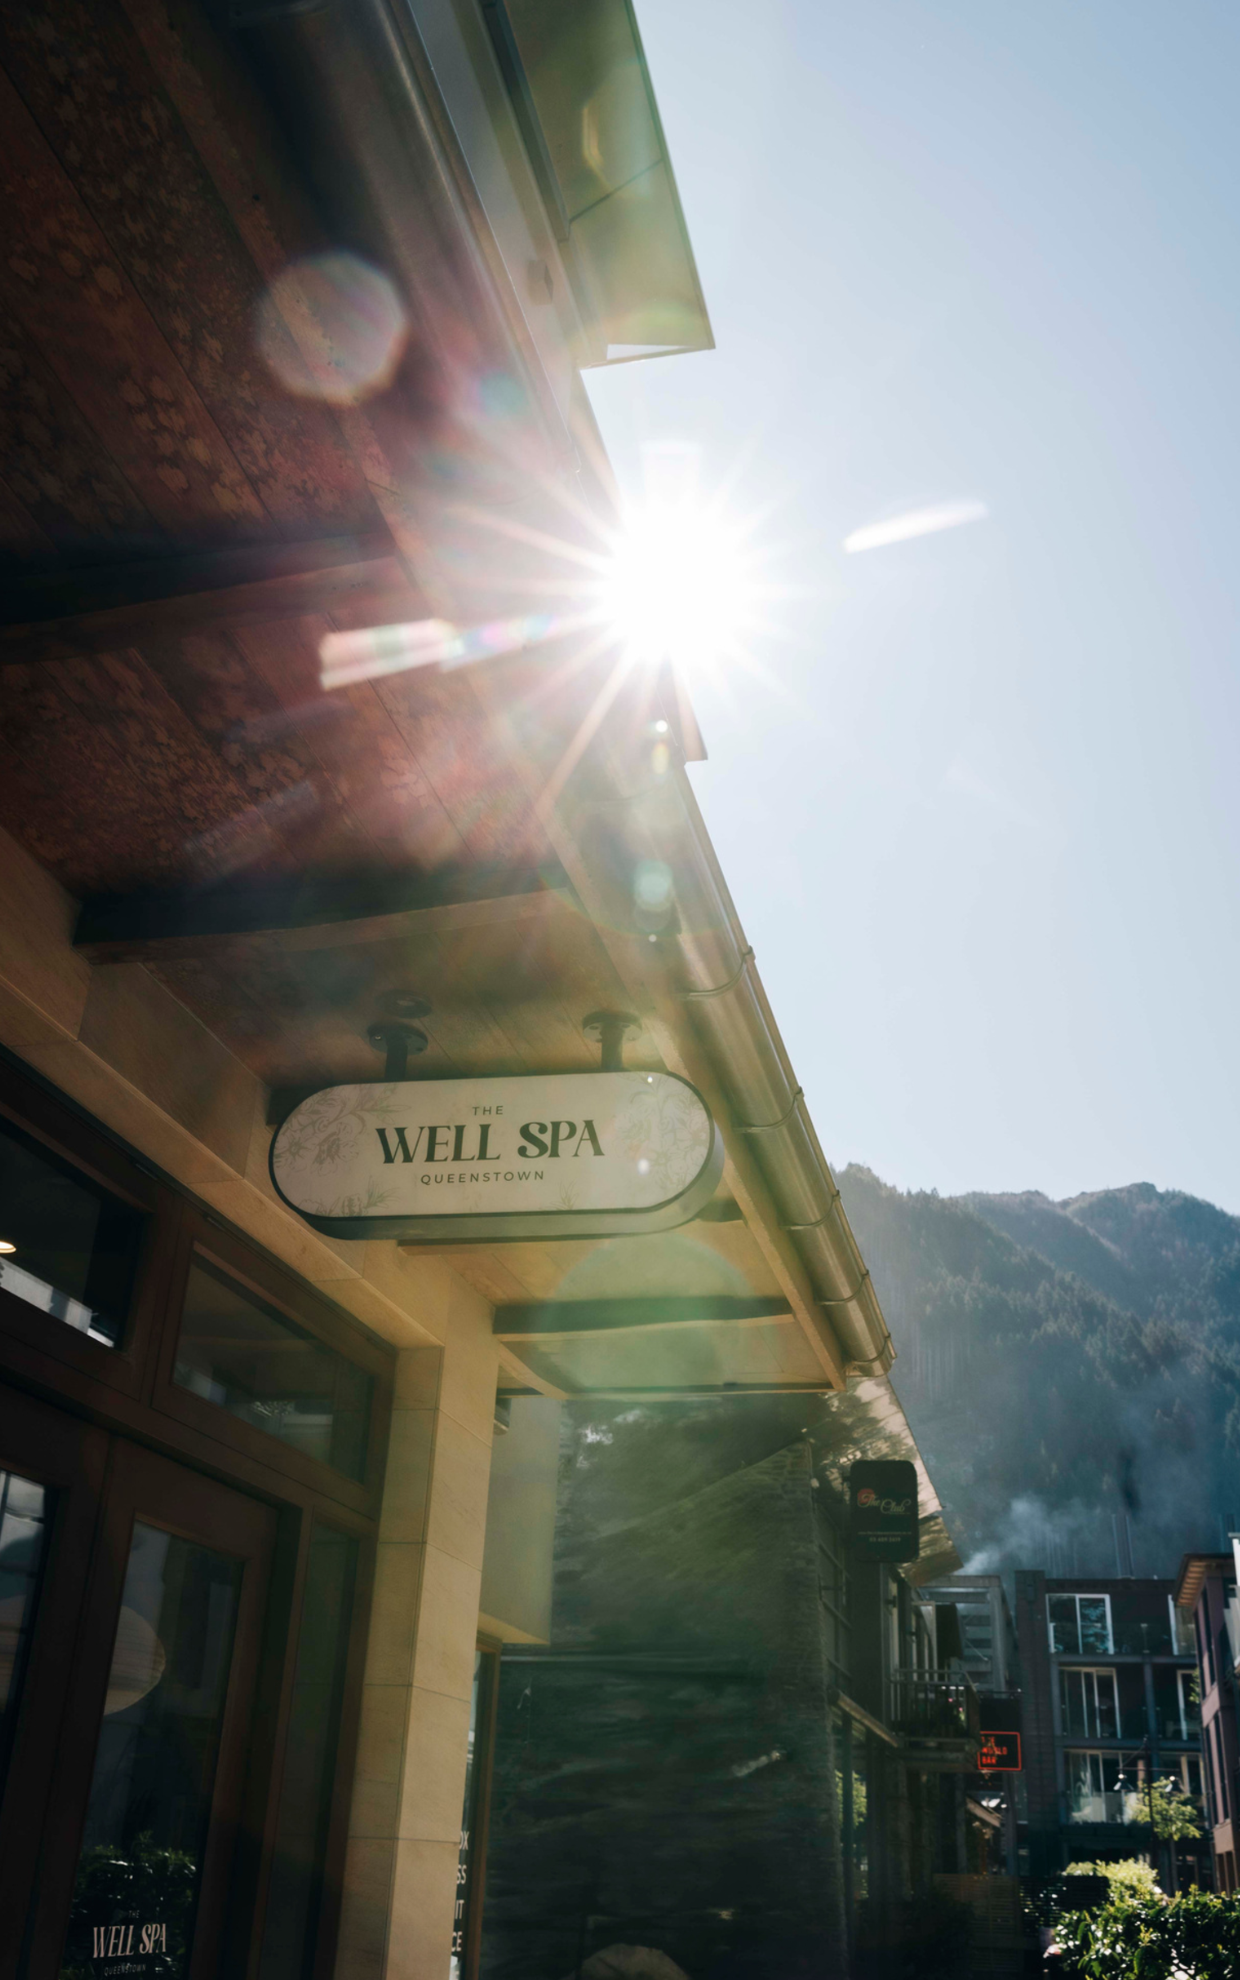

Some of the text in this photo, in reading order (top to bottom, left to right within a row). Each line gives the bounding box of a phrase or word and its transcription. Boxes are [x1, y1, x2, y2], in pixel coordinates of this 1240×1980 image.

[472, 1105, 504, 1116] THE
[375, 1119, 606, 1164] WELL SPA
[420, 1170, 545, 1186] QUEENSTOWN
[880, 1498, 912, 1514] Club
[128, 1909, 140, 1919] THE
[92, 1922, 167, 1959] WELL SPA
[104, 1963, 147, 1977] QUEENSTOWN
